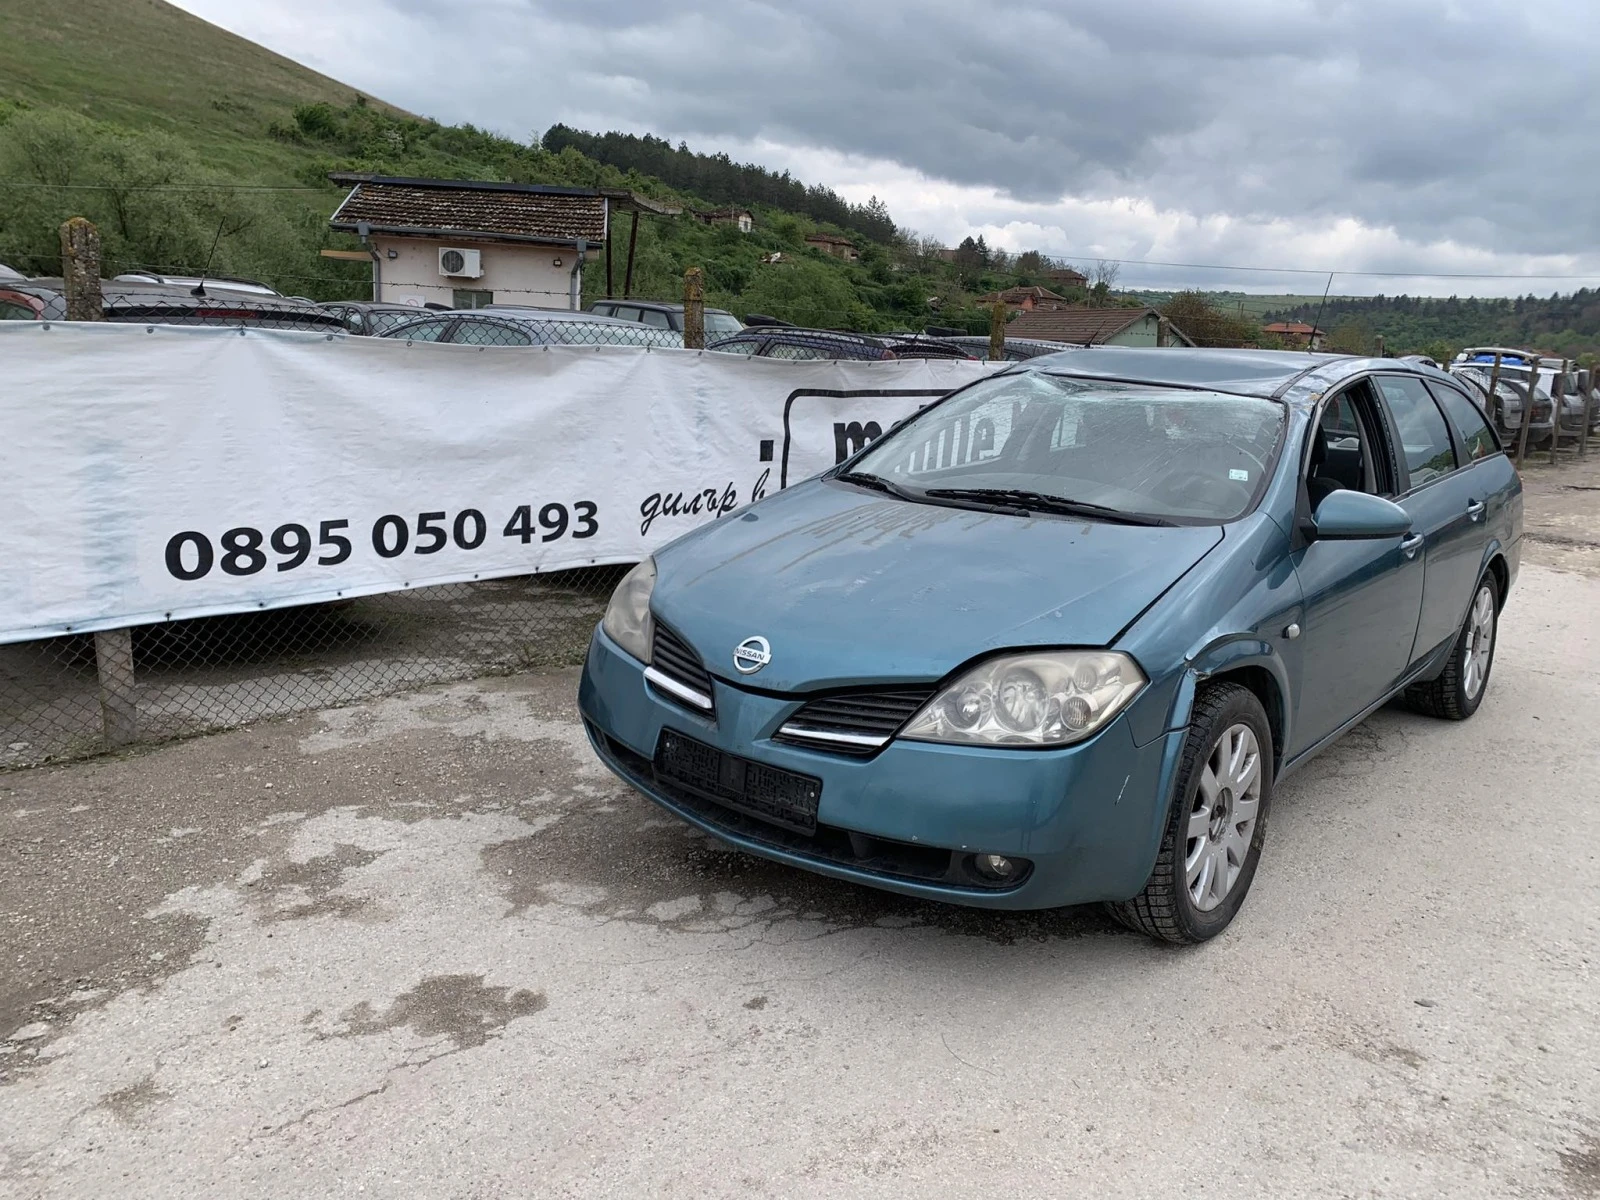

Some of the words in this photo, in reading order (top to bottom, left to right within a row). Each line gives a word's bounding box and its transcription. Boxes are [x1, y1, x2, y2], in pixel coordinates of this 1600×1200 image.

[165, 519, 351, 580] 0895
[372, 509, 486, 558] 050
[503, 501, 598, 544] 493
[735, 647, 766, 661] NISSAN
